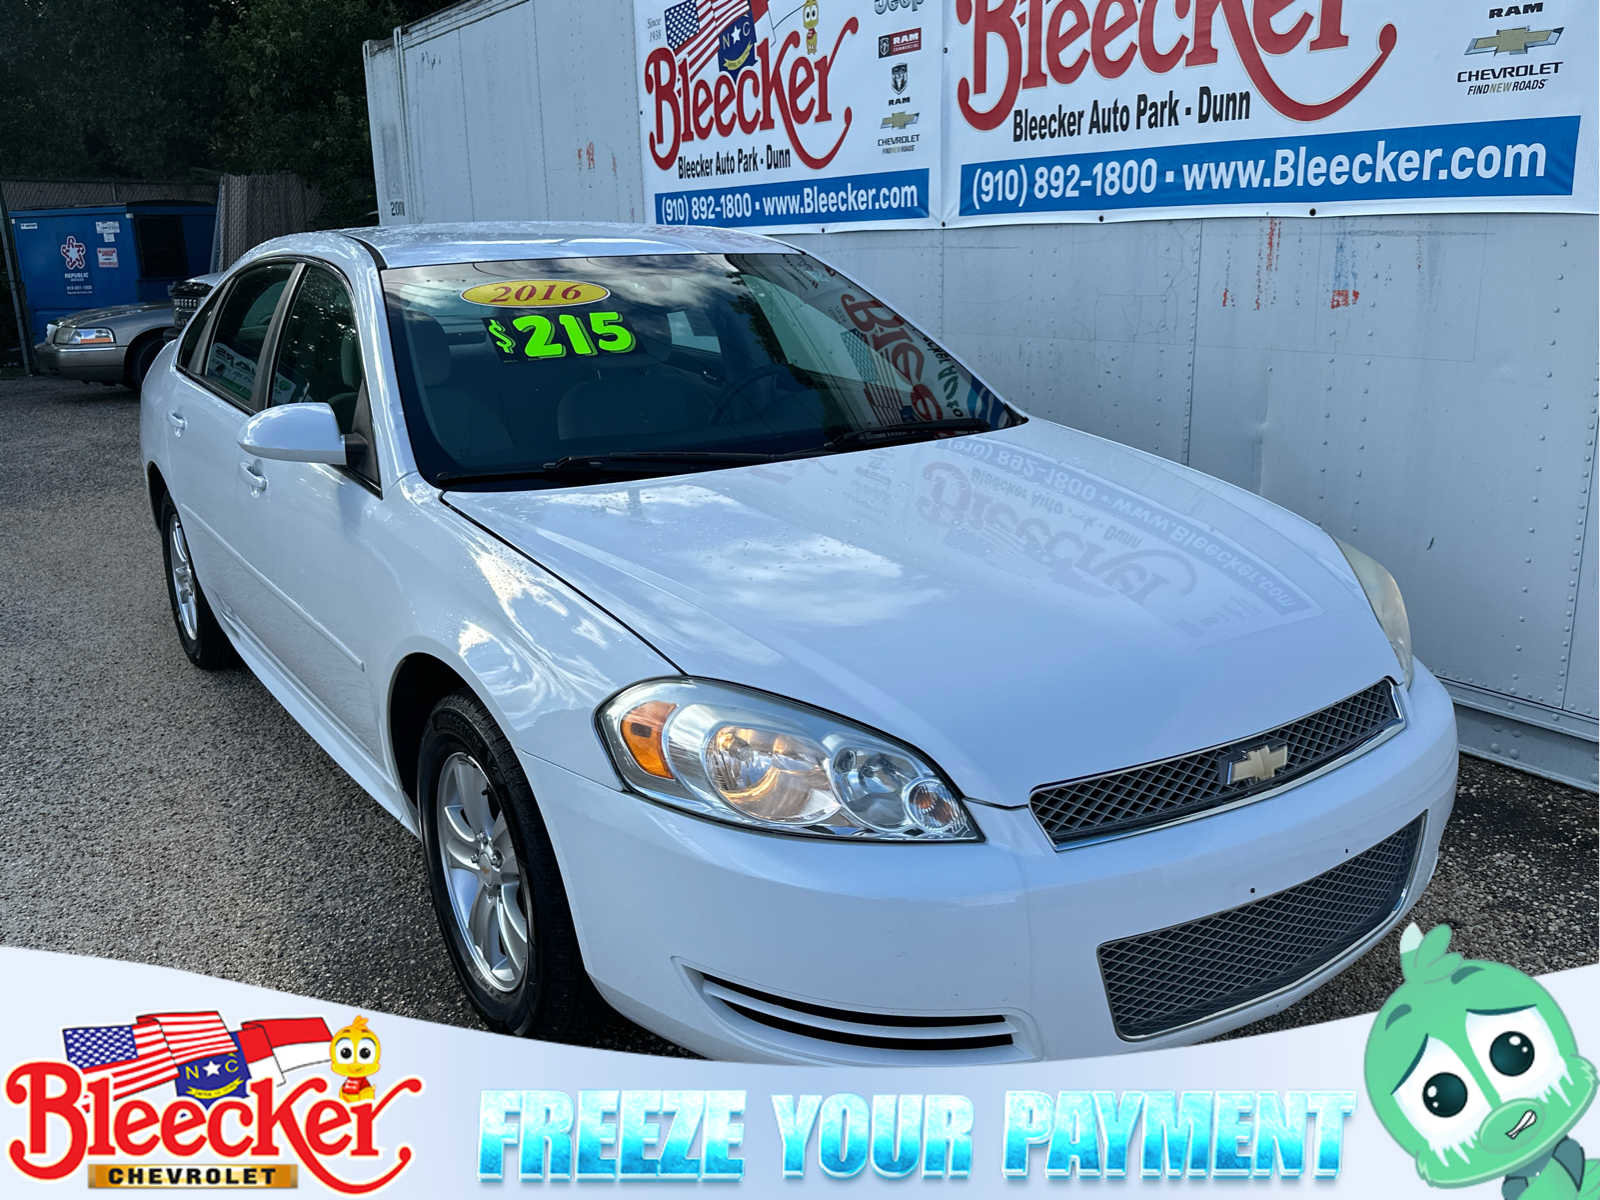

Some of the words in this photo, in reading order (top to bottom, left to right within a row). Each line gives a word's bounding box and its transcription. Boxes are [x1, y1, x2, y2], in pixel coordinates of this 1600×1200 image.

[1488, 2, 1544, 19] RAM
[892, 32, 919, 45] RAM
[1456, 61, 1564, 83] CHEVROLET
[644, 16, 859, 171] Bleecker
[888, 96, 911, 106] RAM
[1013, 104, 1084, 142] Bleecker
[1088, 99, 1130, 134] Auto
[1136, 90, 1180, 129] Park
[1197, 86, 1251, 124] Dunn
[877, 133, 920, 146] CHEVROLET
[678, 153, 713, 179] Bleecker
[715, 151, 735, 175] Auto
[737, 146, 759, 172] Park
[766, 144, 791, 169] Dunn
[972, 164, 1028, 210] (910)
[1033, 158, 1158, 199] 892-1800
[1182, 140, 1546, 191] www.Bleecker.com
[662, 195, 689, 224] (910)
[691, 192, 752, 219] 892-1800
[762, 183, 919, 217] www.Bleecker.com
[489, 284, 582, 303] 2016
[488, 311, 637, 358] $215
